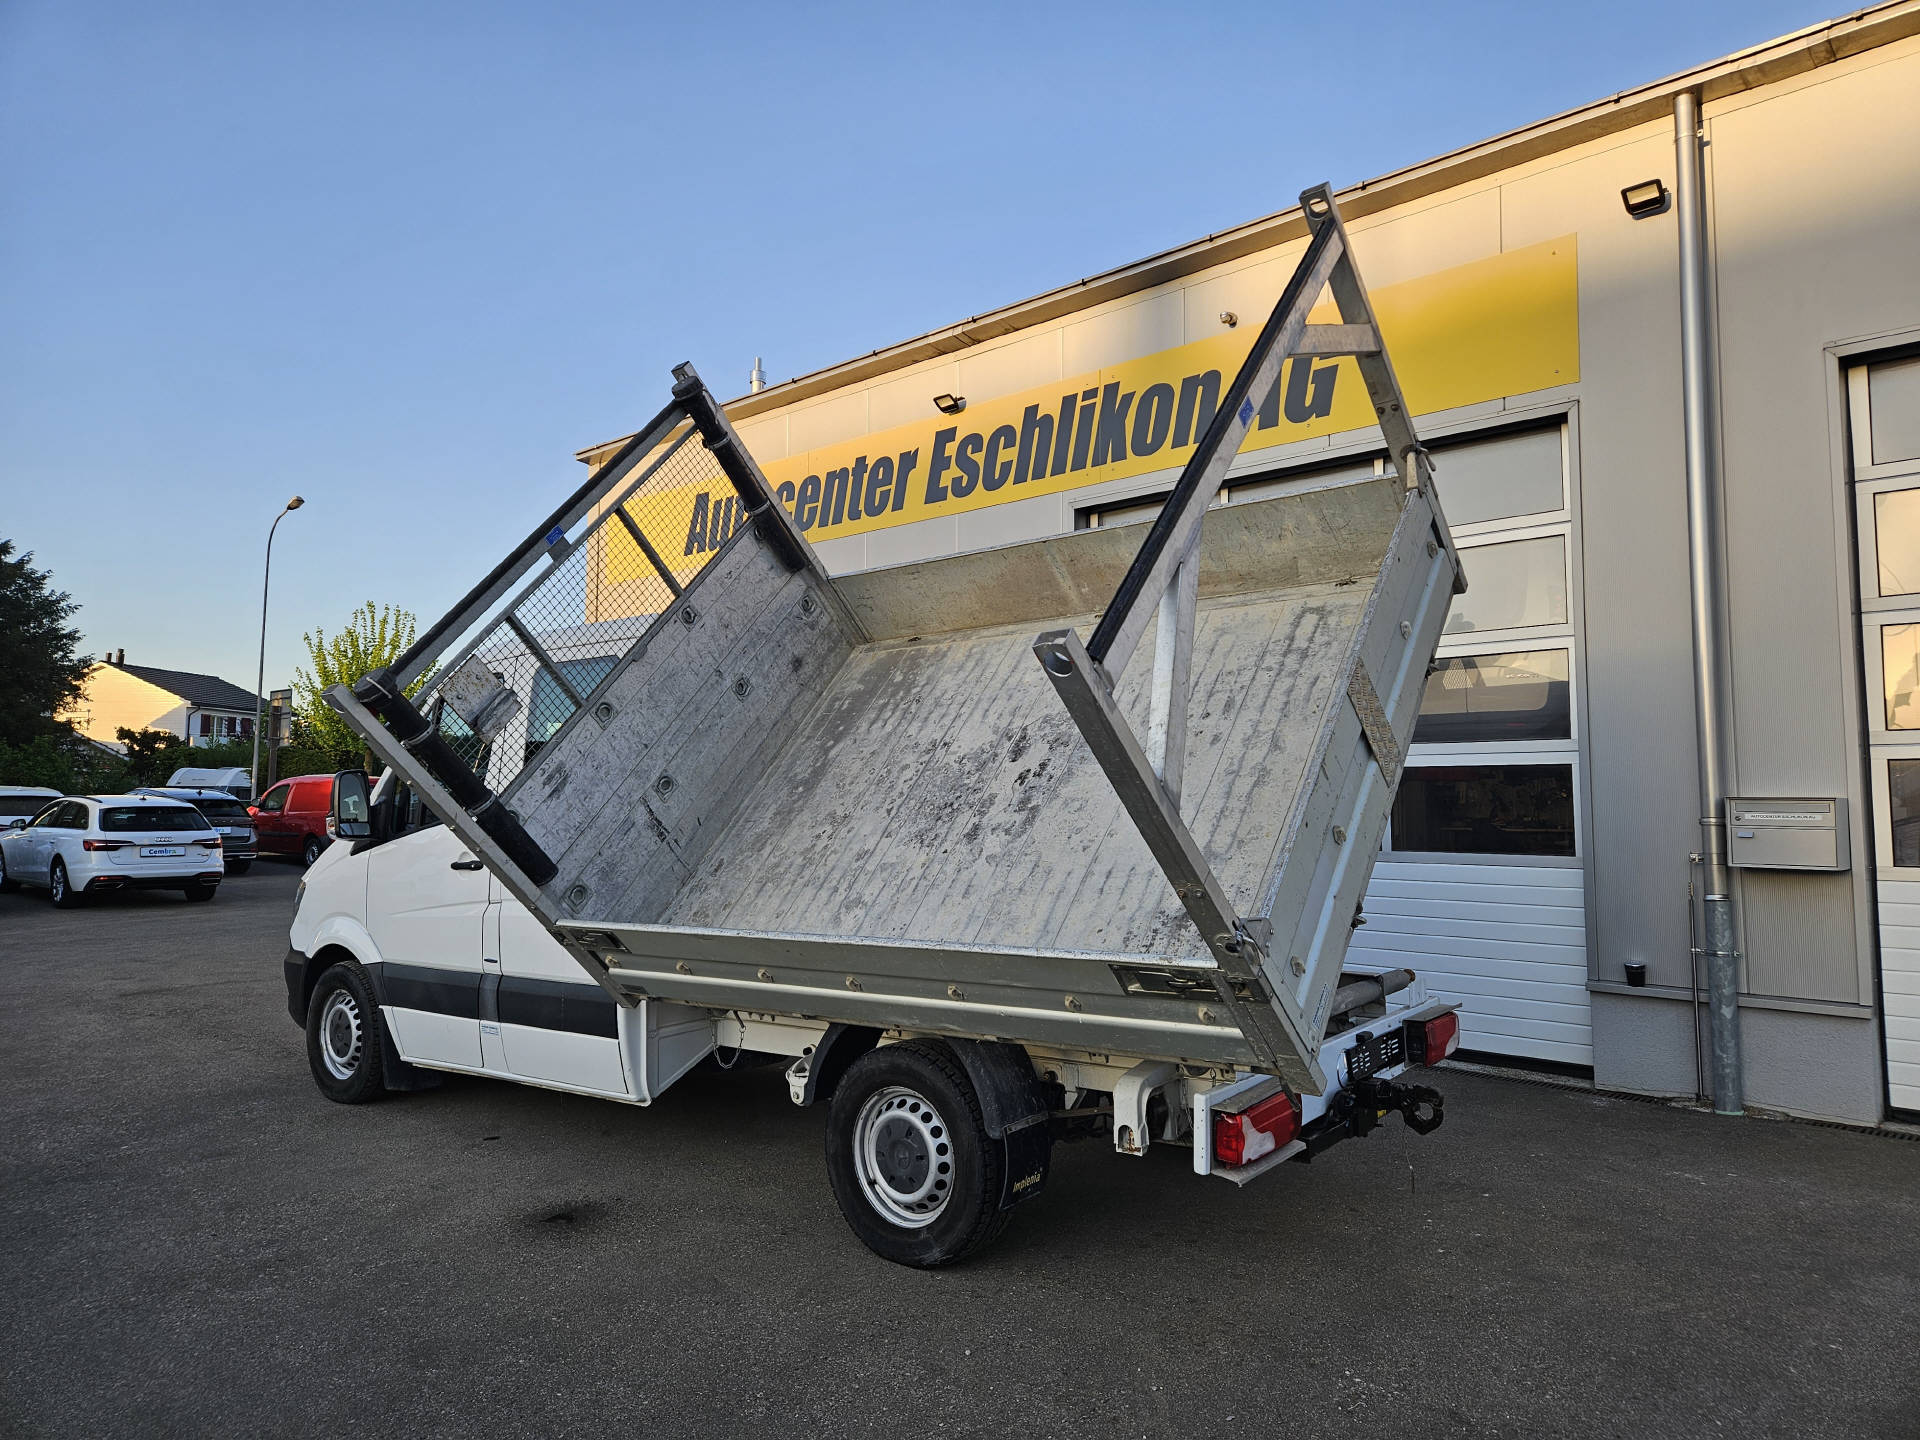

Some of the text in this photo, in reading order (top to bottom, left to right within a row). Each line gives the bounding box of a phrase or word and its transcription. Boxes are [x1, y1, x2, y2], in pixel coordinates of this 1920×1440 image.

[683, 447, 919, 557] Aucenter
[924, 369, 1222, 505] Eschlikon
[148, 847, 177, 855] Cembra
